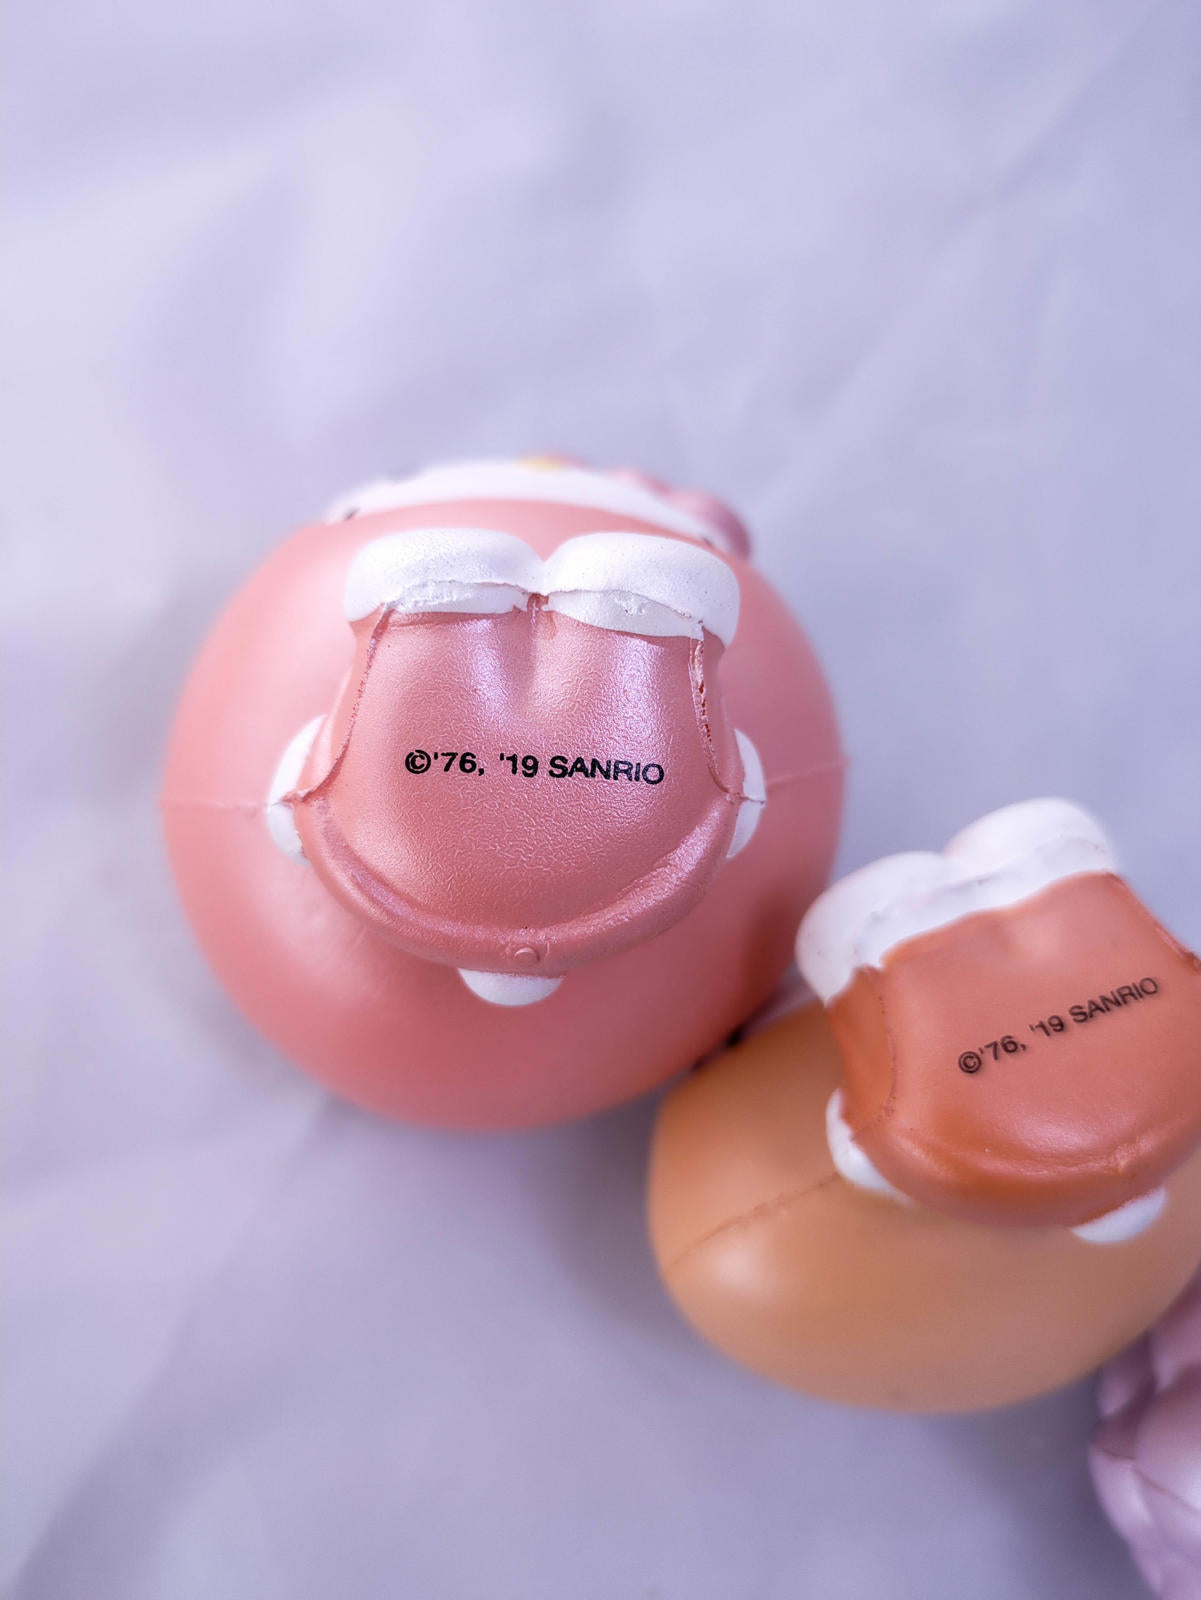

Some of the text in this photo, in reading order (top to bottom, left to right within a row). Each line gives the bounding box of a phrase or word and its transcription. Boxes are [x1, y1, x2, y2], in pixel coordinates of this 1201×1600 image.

[499, 752, 540, 779] '19
[548, 755, 665, 786] SANRIO
[1029, 1014, 1066, 1037] '19
[1069, 976, 1160, 1024] SANRIO
